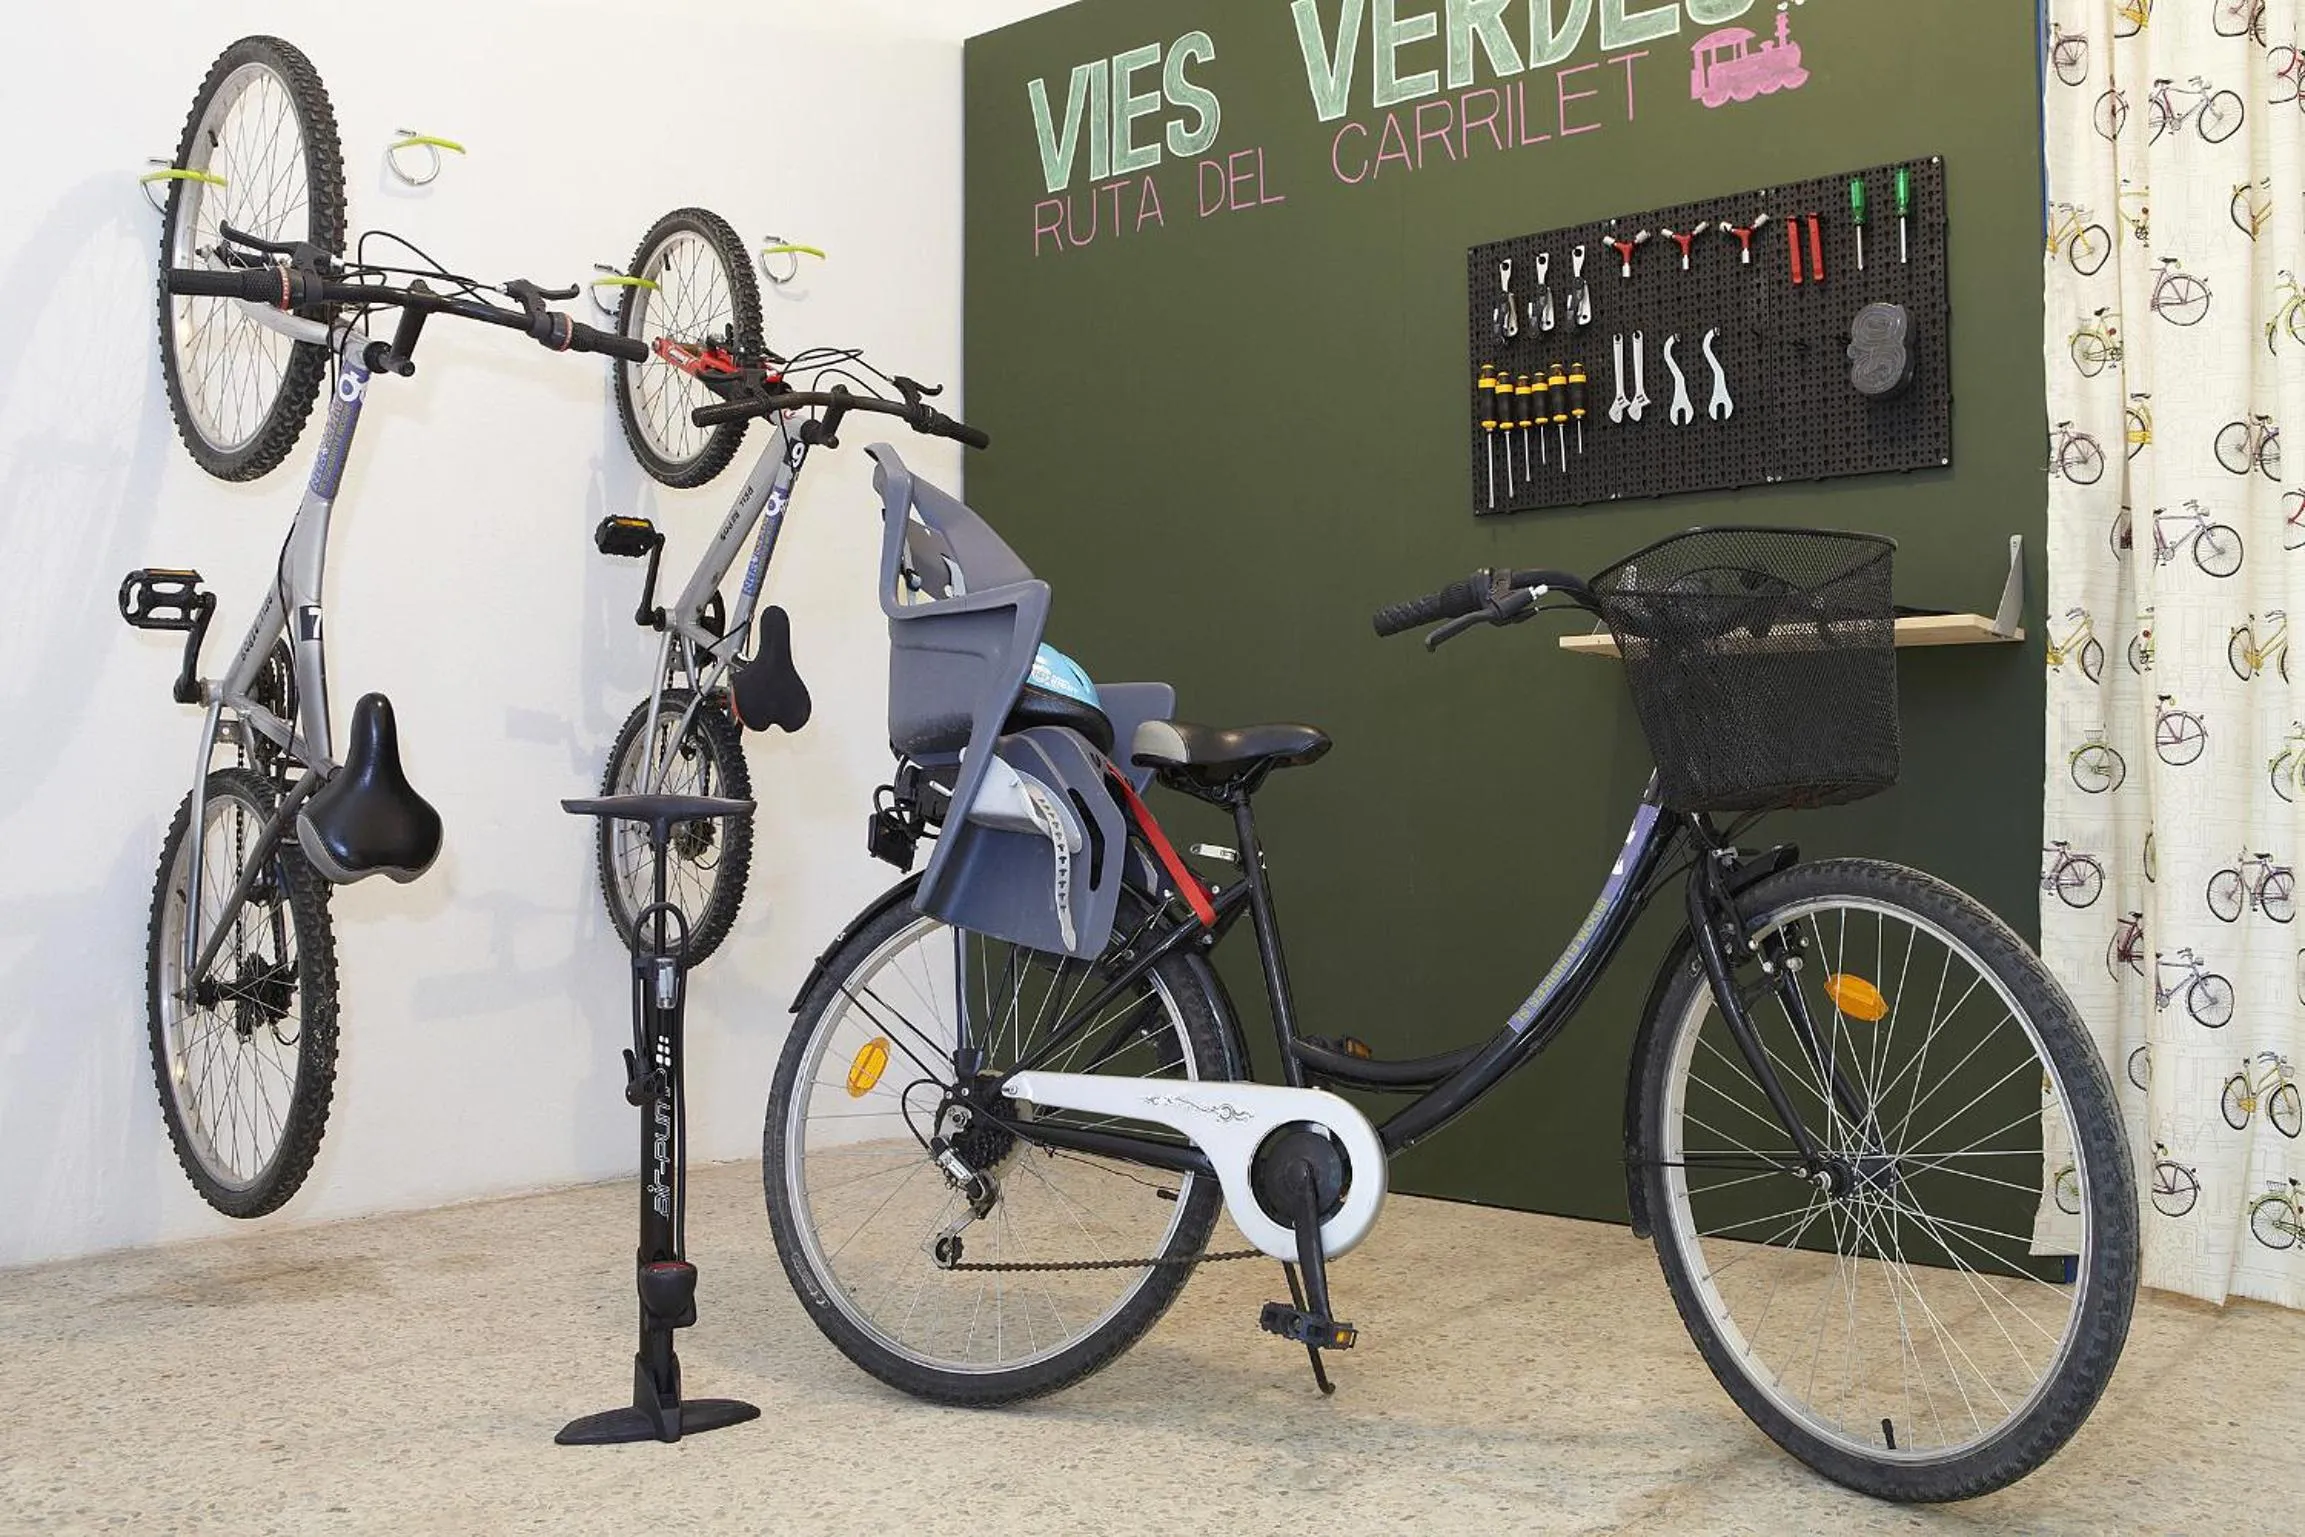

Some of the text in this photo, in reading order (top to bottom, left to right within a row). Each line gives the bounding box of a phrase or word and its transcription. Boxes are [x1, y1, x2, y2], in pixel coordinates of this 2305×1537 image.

[1027, 0, 1755, 193] VIES VER
[1034, 50, 1650, 257] RUTA DEL CARRILET
[791, 442, 805, 469] 9
[308, 606, 322, 639] 7
